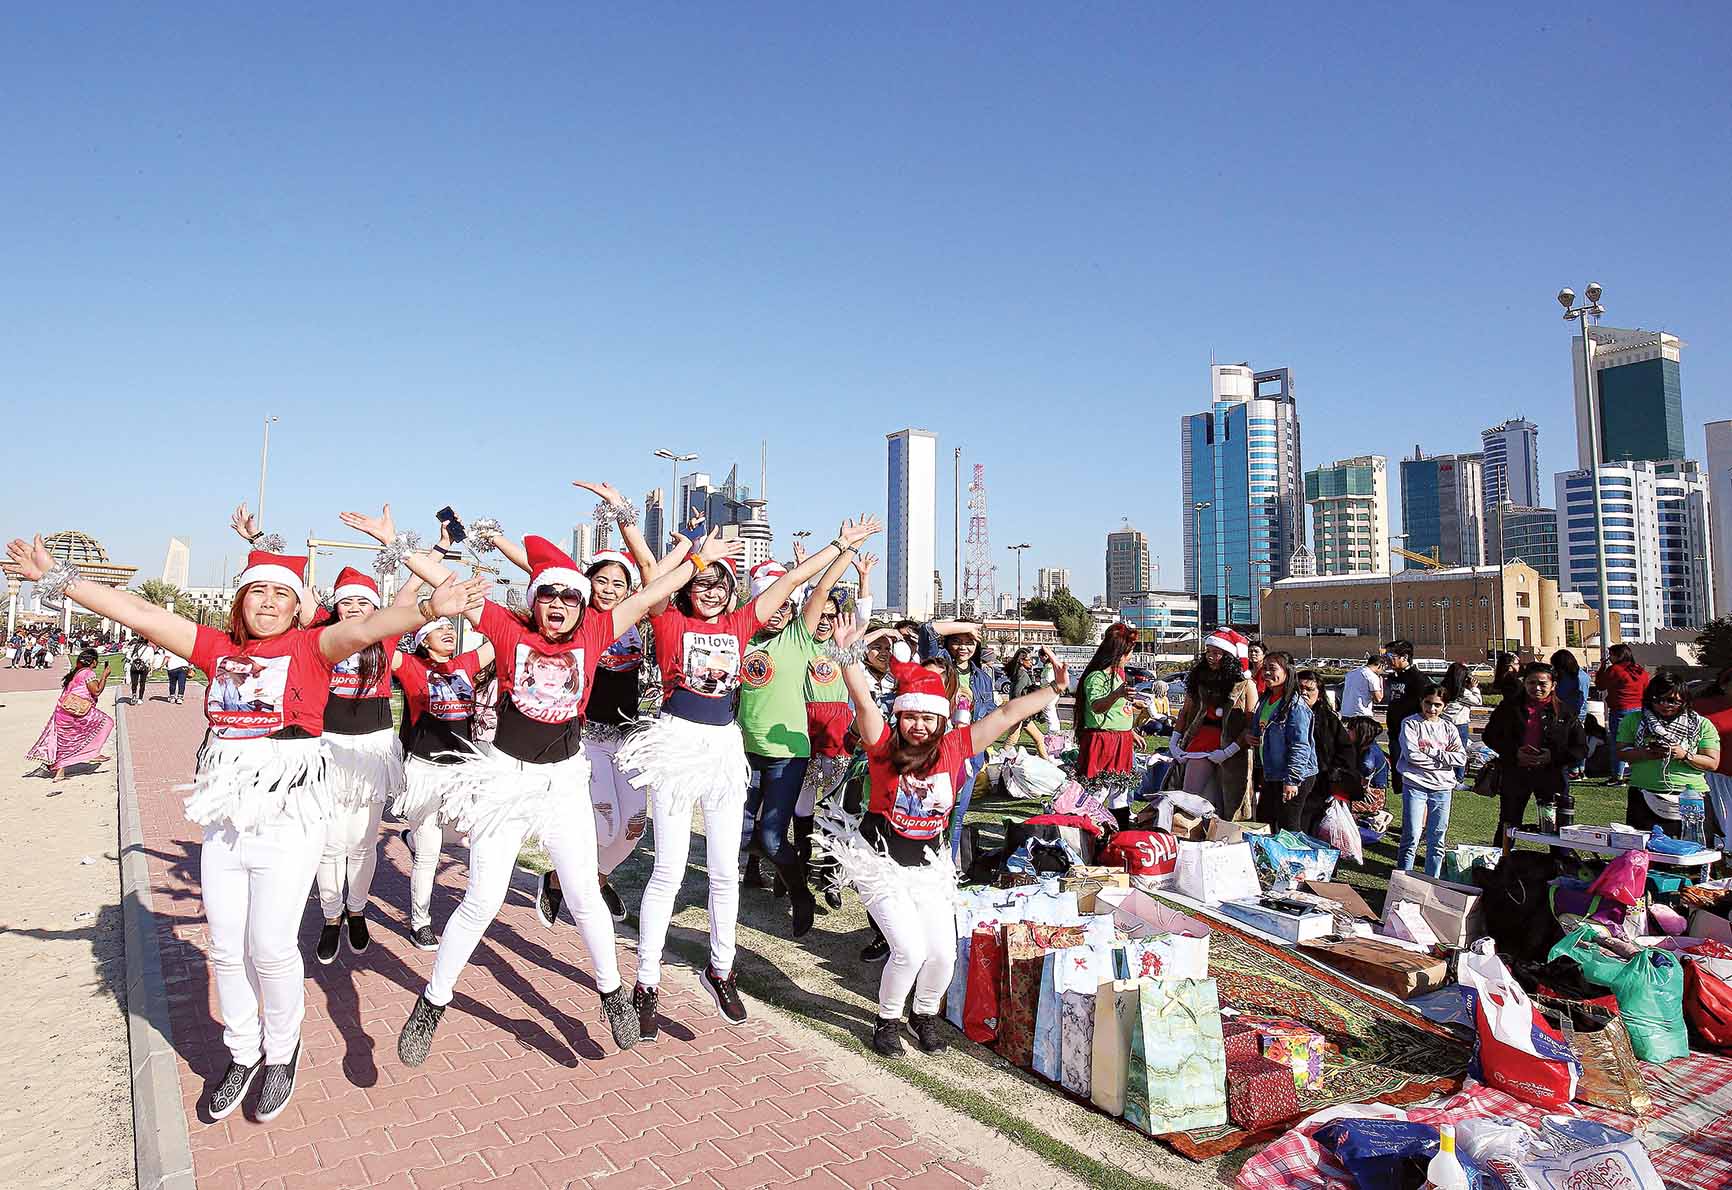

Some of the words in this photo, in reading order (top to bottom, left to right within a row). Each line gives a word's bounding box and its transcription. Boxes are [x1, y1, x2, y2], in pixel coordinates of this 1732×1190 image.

[693, 634, 706, 645] in
[708, 636, 735, 648] love
[1135, 832, 1179, 868] SAL
